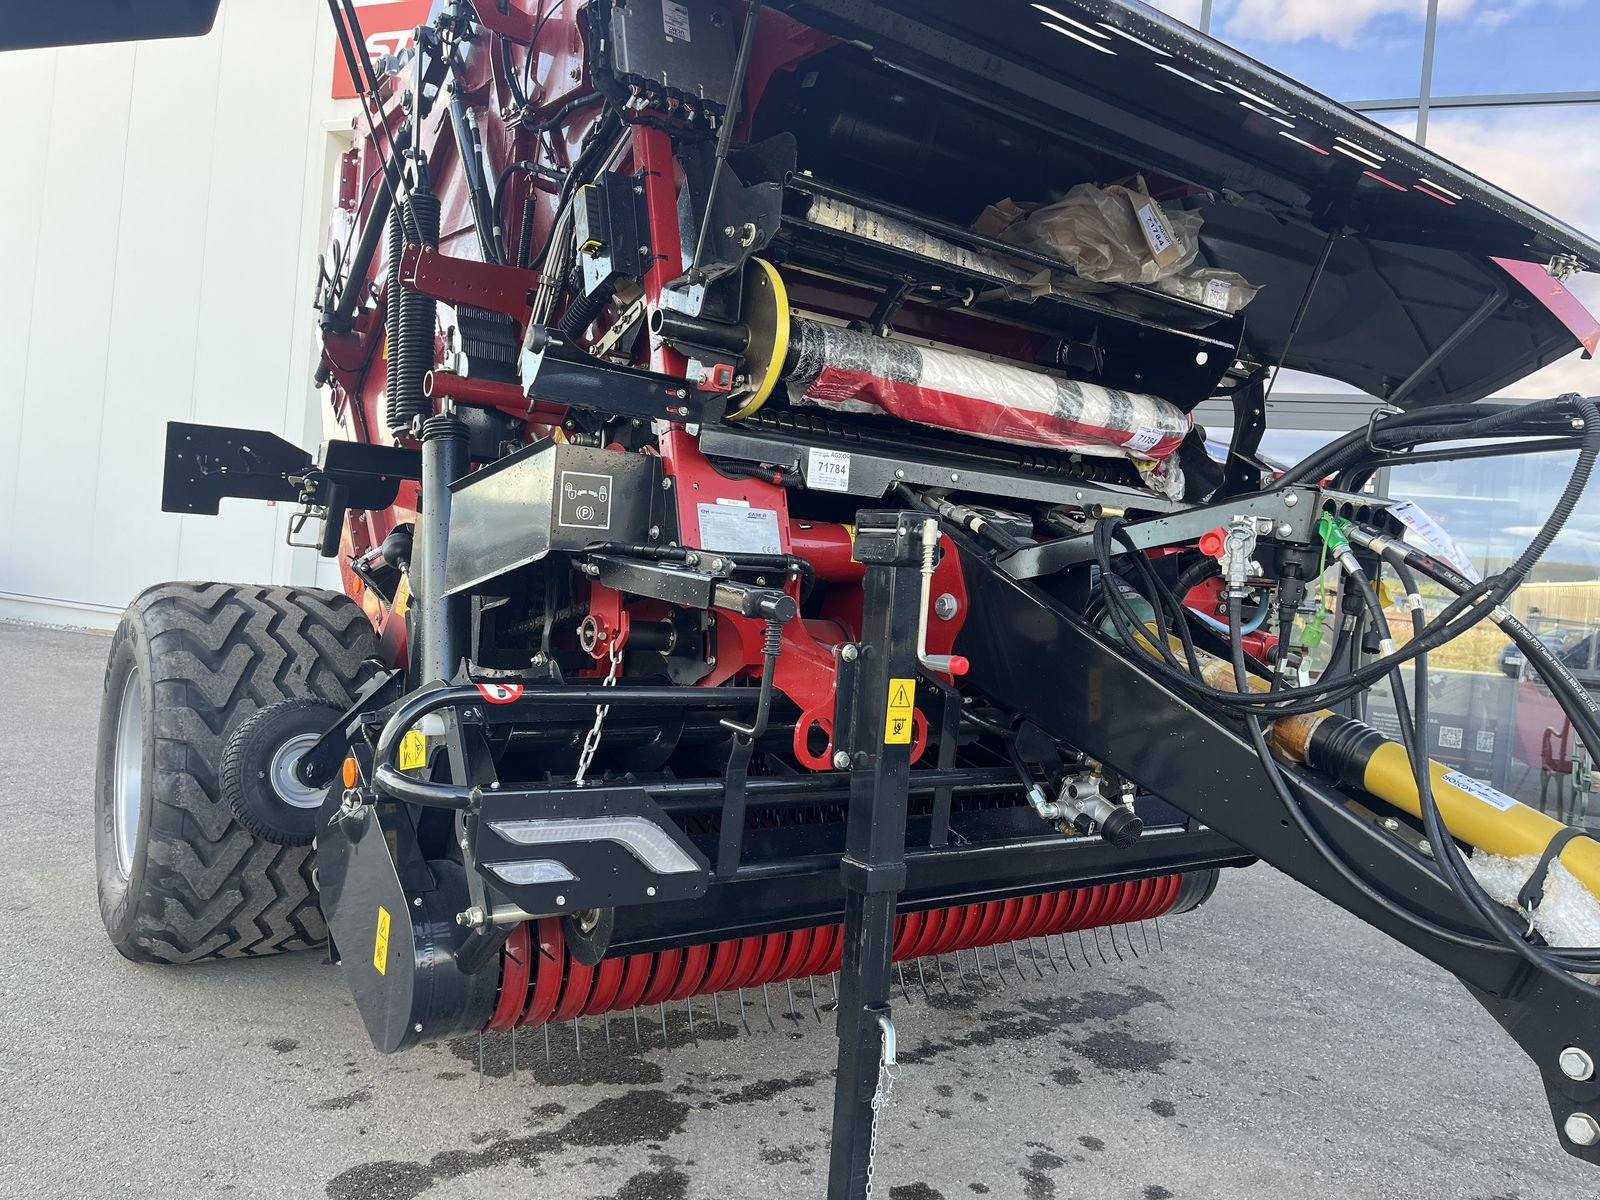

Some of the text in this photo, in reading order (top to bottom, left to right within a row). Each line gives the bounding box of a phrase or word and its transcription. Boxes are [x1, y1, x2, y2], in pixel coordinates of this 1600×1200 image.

[1146, 215, 1165, 247] 71784
[818, 461, 846, 475] 71784
[1509, 617, 1521, 630] BAR
[1539, 646, 1553, 661] Flame
[1551, 658, 1571, 681] resistant
[1568, 677, 1583, 694] MSHA
